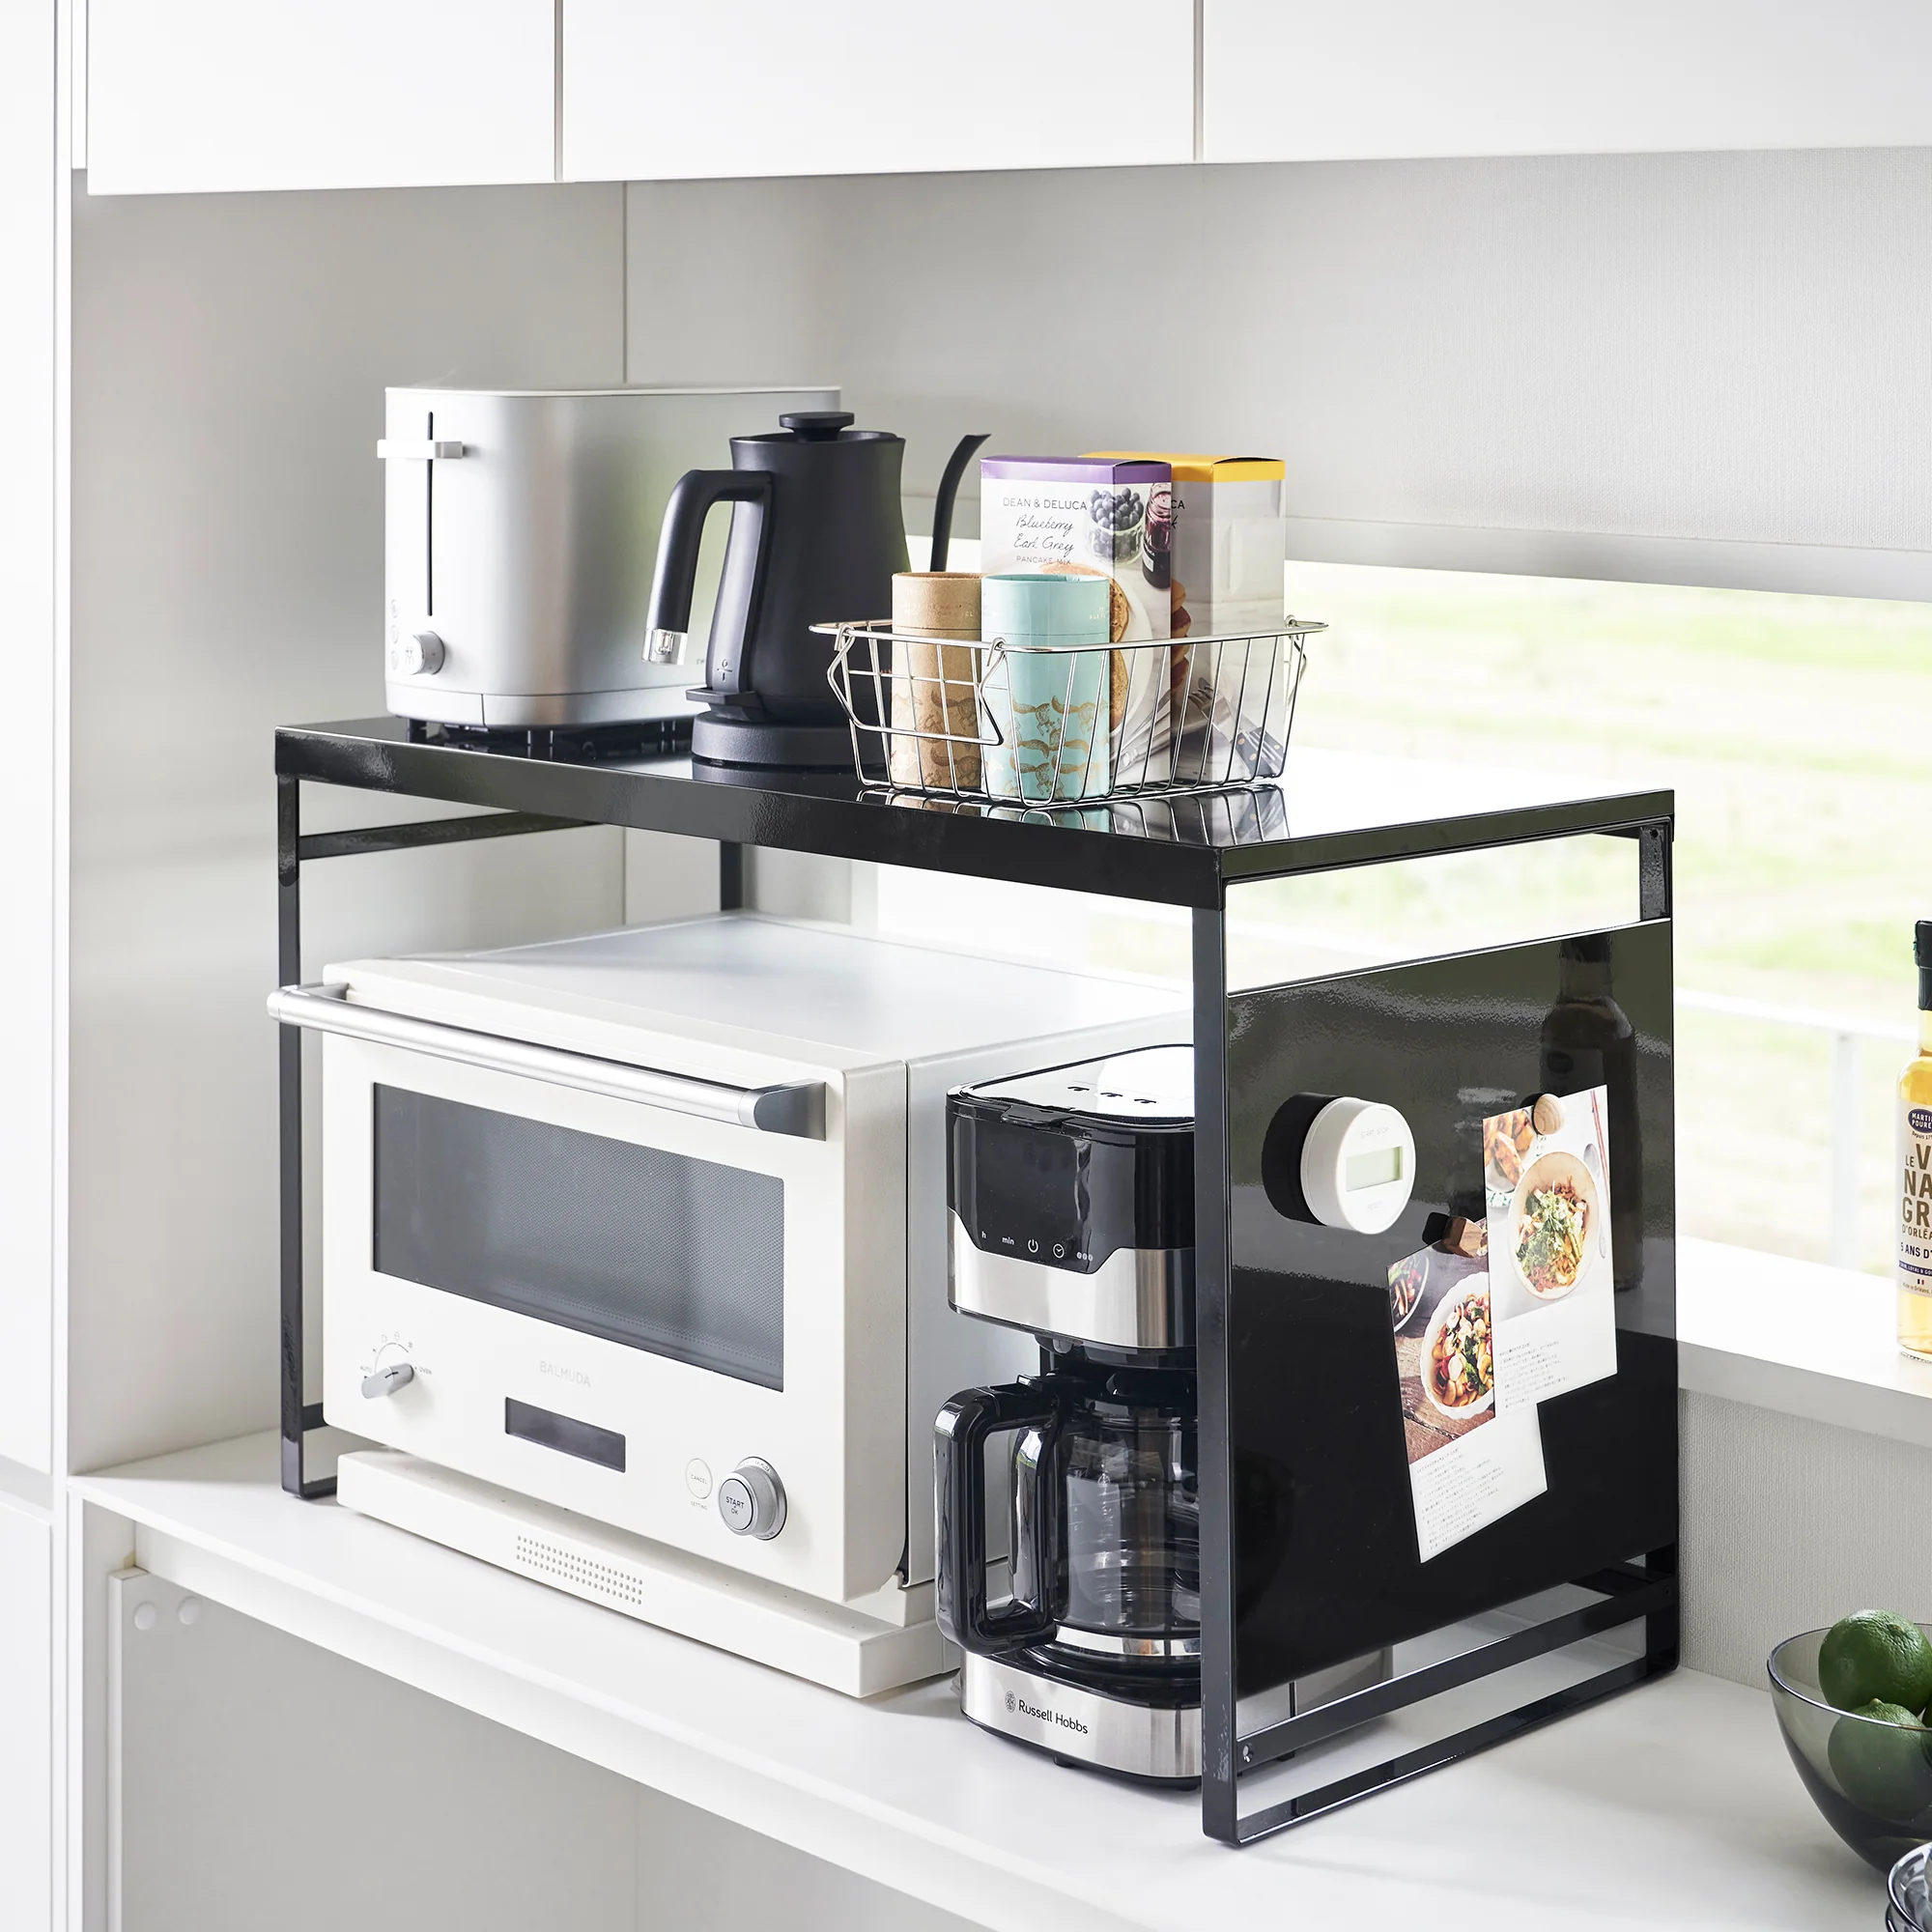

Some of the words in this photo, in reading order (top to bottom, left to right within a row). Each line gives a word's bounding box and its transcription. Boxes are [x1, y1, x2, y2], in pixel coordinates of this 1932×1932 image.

[1003, 497, 1031, 507] DEAN
[1033, 498, 1040, 508] &
[1043, 498, 1088, 510] DELUCA
[1015, 514, 1074, 537] Blueberry
[1013, 532, 1039, 549] Earl
[1041, 535, 1075, 557] Grey
[1015, 554, 1054, 564] PANCAKE
[1905, 1154, 1915, 1167] LE
[1002, 1236, 1015, 1245] min
[1905, 1244, 1920, 1257] ANS
[540, 1360, 591, 1387] BALMUDA
[691, 1473, 708, 1485] CANCEL
[690, 1500, 708, 1511] SETTING
[725, 1495, 745, 1509] START
[1018, 1699, 1053, 1722] Russell
[1055, 1712, 1089, 1735] Hobbs
